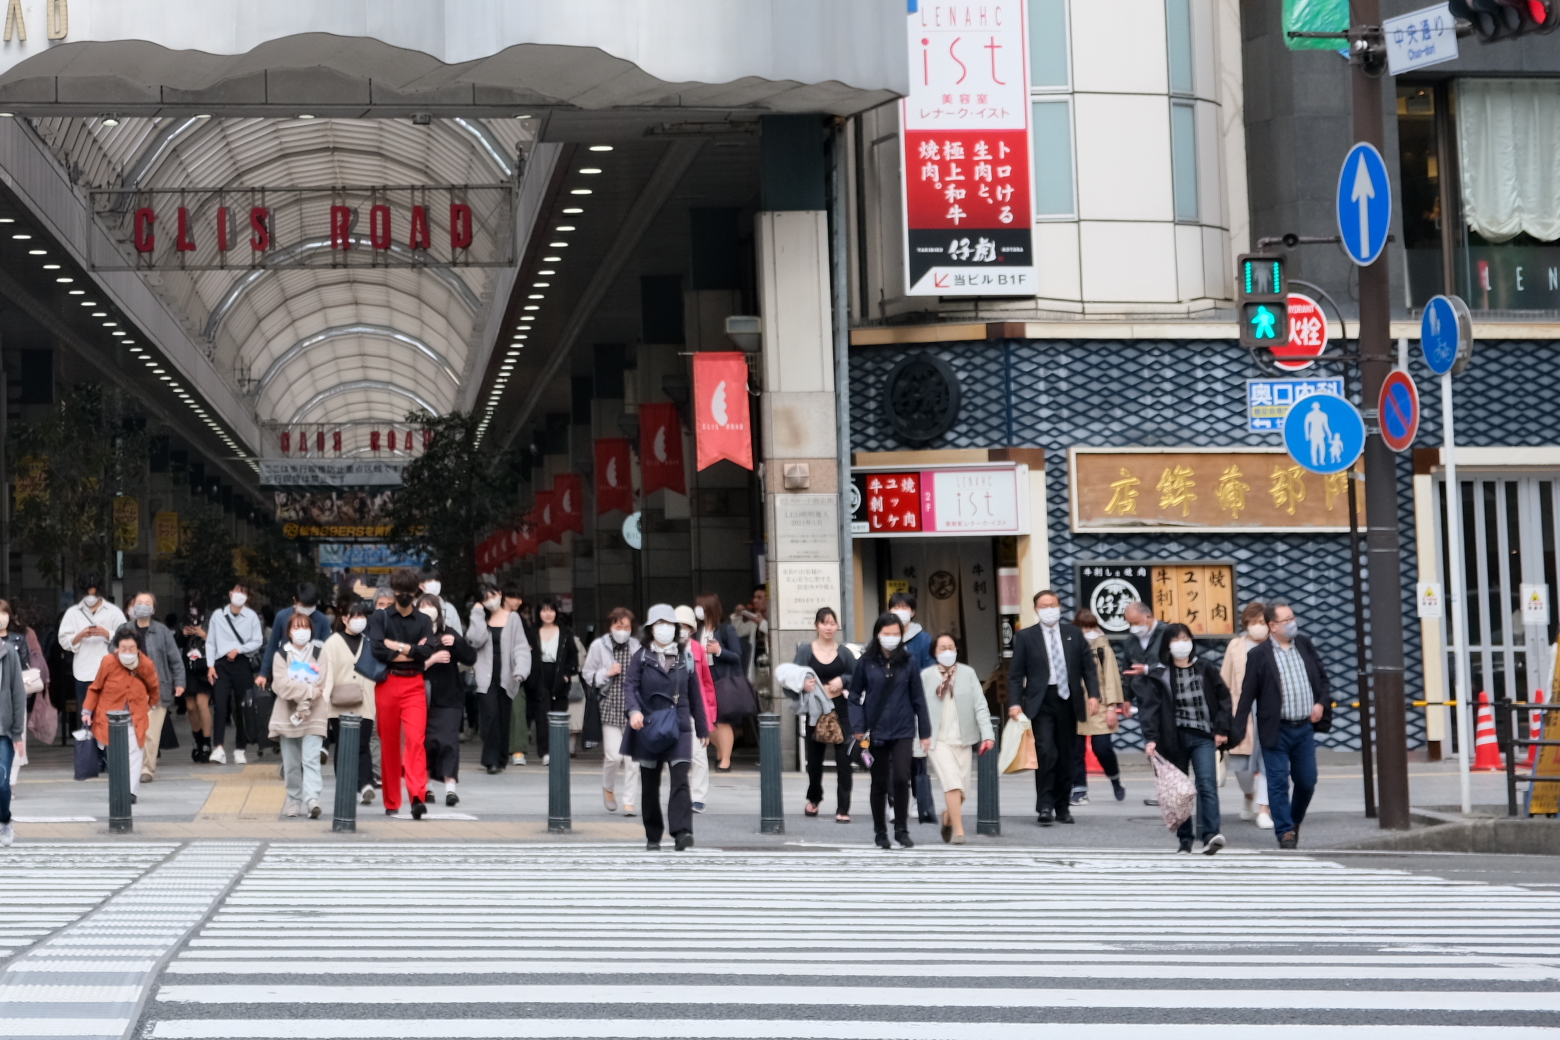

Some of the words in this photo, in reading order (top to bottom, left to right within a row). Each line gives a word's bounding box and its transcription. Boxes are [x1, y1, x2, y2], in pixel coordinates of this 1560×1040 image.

[921, 6, 1003, 27] LENAHC
[1393, 15, 1444, 49] 中央通り
[941, 93, 989, 105] 美容室
[918, 140, 943, 190] 焼肉。
[943, 141, 967, 226] 極上和牛
[996, 141, 1015, 225] トロける
[134, 206, 270, 253] CLIS
[330, 203, 473, 251] ROAD
[947, 236, 997, 263] 仔虎
[954, 274, 994, 287] 当ビル
[998, 274, 1027, 285] B1F
[869, 477, 884, 529] 牛刺し
[885, 478, 900, 528] ユッケ
[901, 476, 917, 528] 焼肉
[972, 562, 987, 611] 牛刺し
[1082, 567, 1147, 577] 牛刺しと焼肉
[1155, 569, 1173, 624] 牛刺し
[1209, 570, 1229, 622] 焼肉
[1183, 571, 1200, 624] ユッケ
